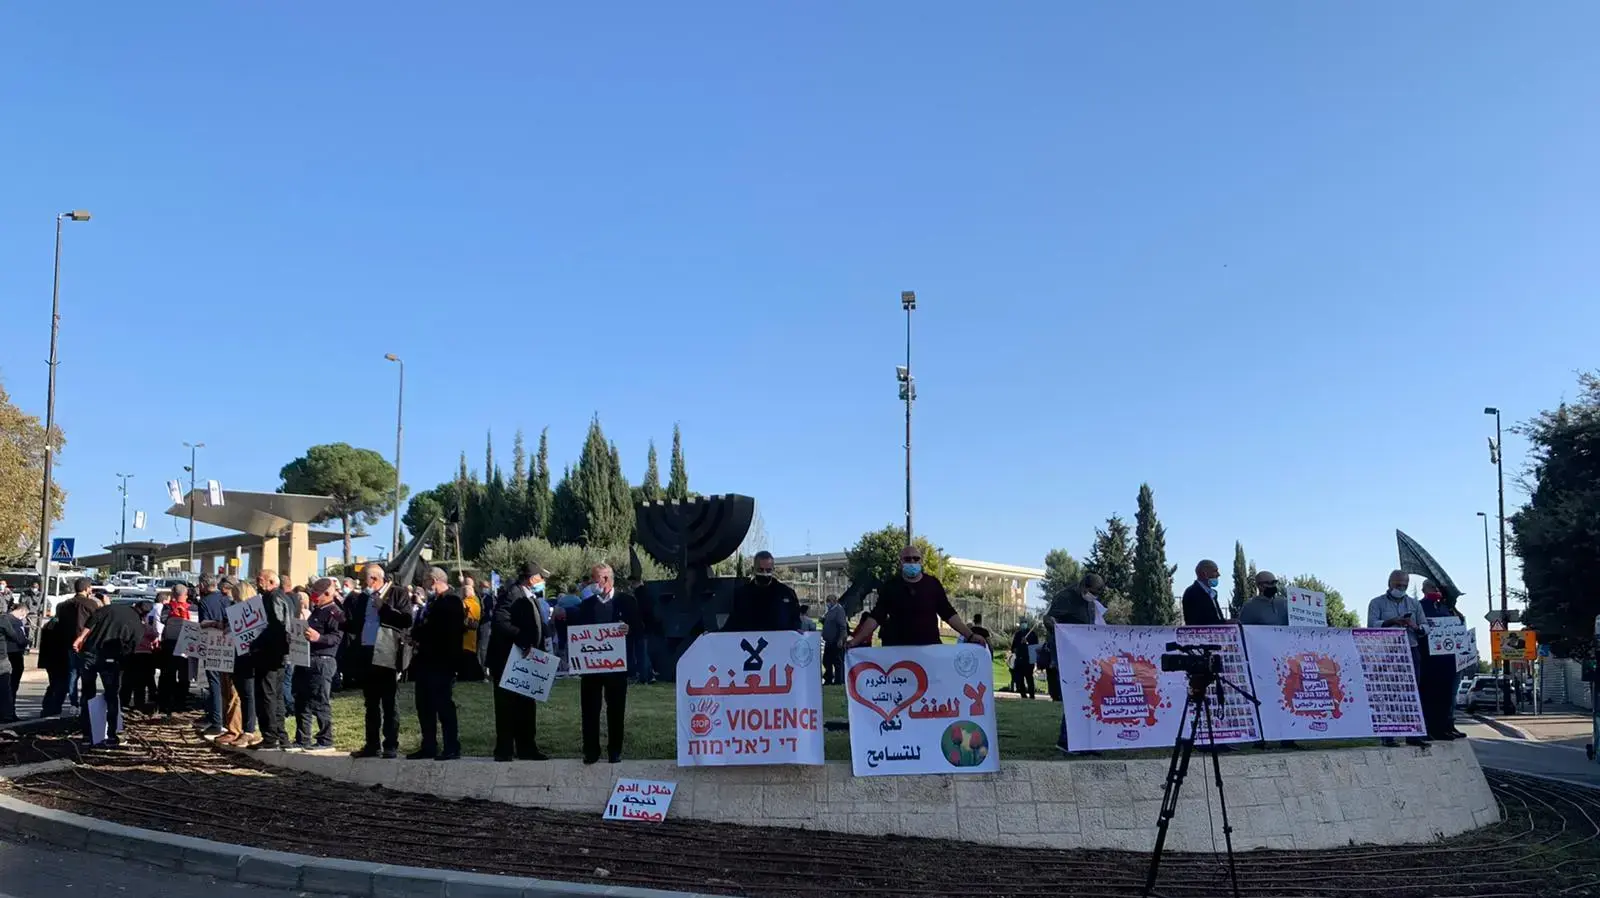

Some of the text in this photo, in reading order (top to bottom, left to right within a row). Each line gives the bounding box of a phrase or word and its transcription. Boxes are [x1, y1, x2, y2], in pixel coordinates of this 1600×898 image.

[240, 631, 255, 642] אני
[570, 630, 591, 643] الدم
[581, 642, 614, 655] نتيجة
[740, 637, 768, 671] لا
[584, 657, 625, 670] صمتنا
[686, 664, 794, 696] للعنف
[865, 675, 908, 688] مجد الكروم
[872, 692, 892, 704] القلب
[908, 681, 986, 719] لا للعنف
[1103, 705, 1148, 715] مش رخيص
[1294, 701, 1317, 709] رخيص
[692, 719, 708, 728] STOP
[726, 708, 817, 731] VIOLENCE
[880, 714, 902, 736] نعم
[688, 736, 797, 755] די לאלימות
[867, 745, 921, 768] للتسامح
[616, 783, 672, 796] شلال الدم
[622, 794, 656, 806] نتيجة
[622, 805, 662, 820] صمتنا
